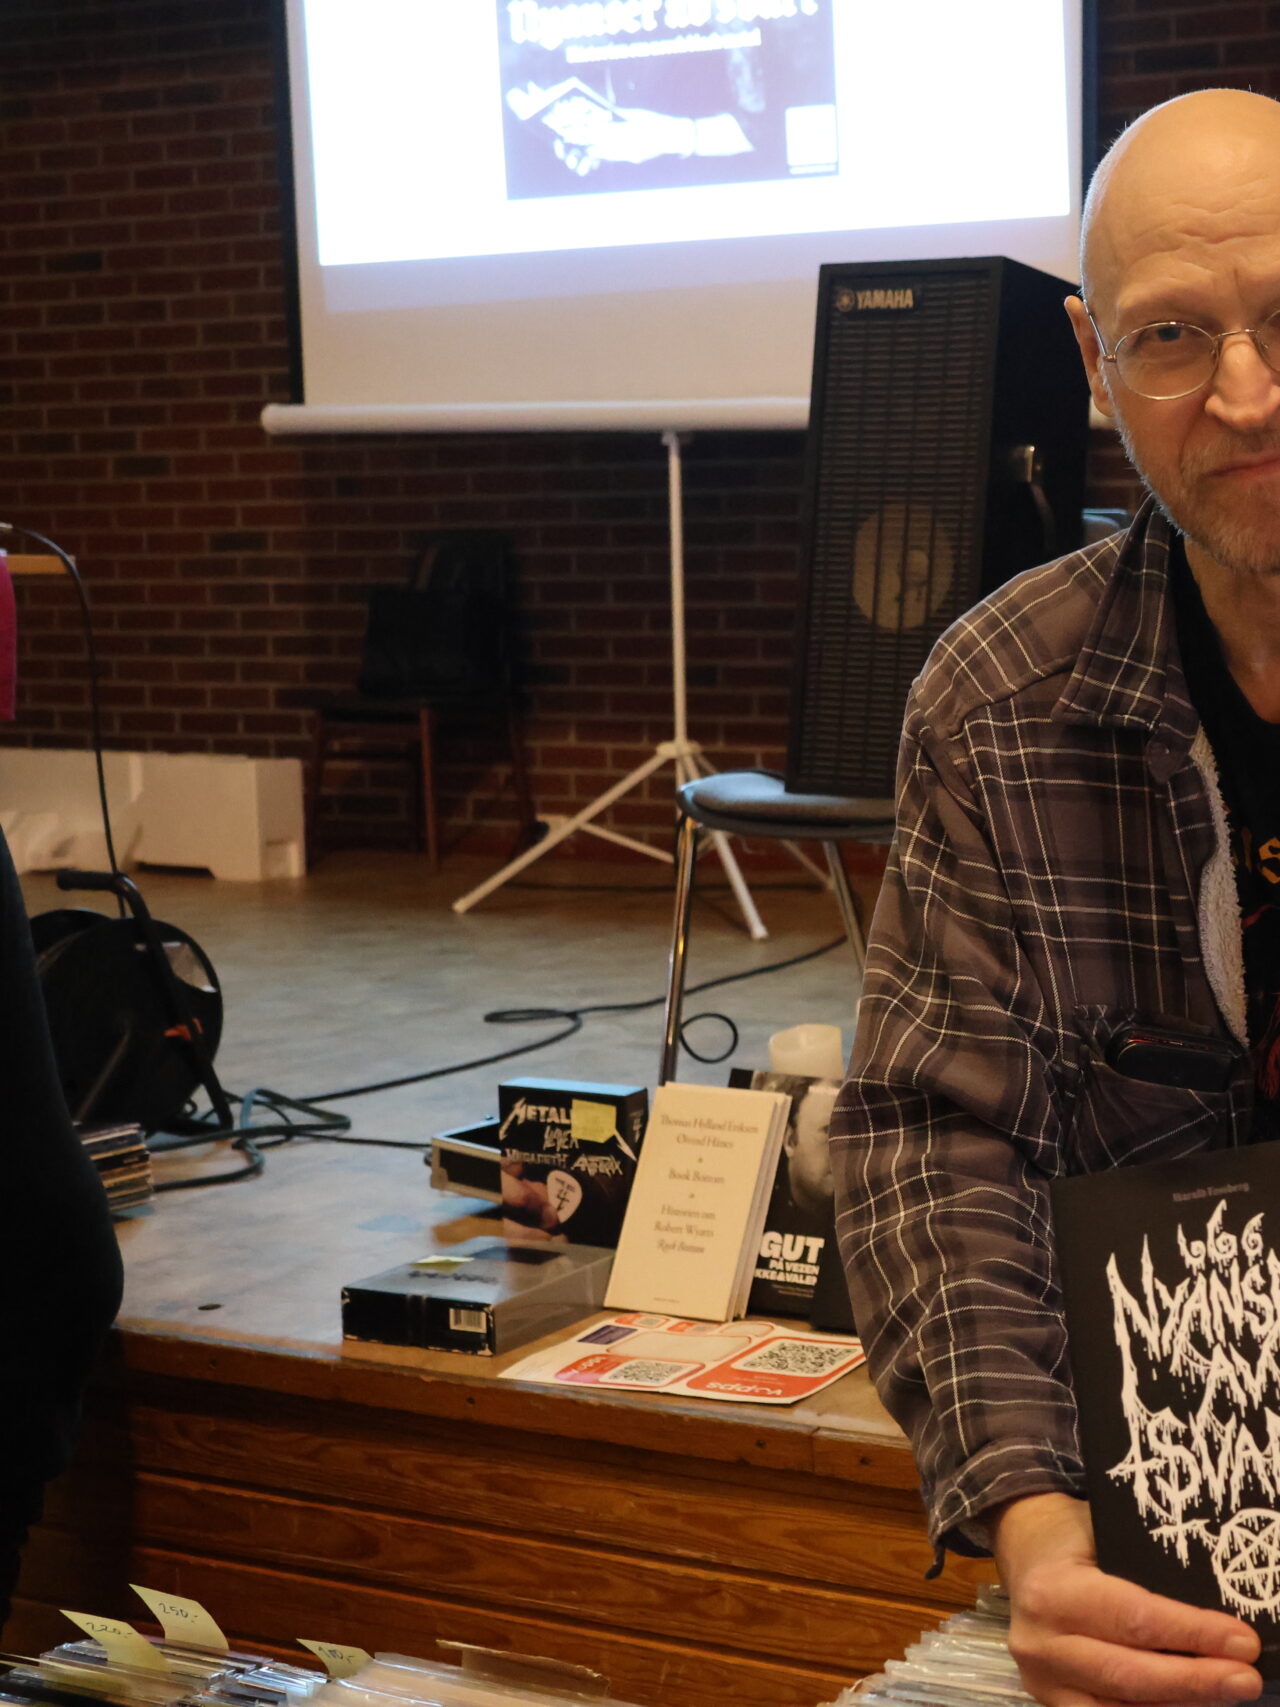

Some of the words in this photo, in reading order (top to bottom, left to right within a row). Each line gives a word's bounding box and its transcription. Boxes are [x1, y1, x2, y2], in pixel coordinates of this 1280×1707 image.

[856, 289, 914, 309] YAMAHA
[760, 1231, 826, 1264] GUT
[1198, 1341, 1273, 1413] AV
